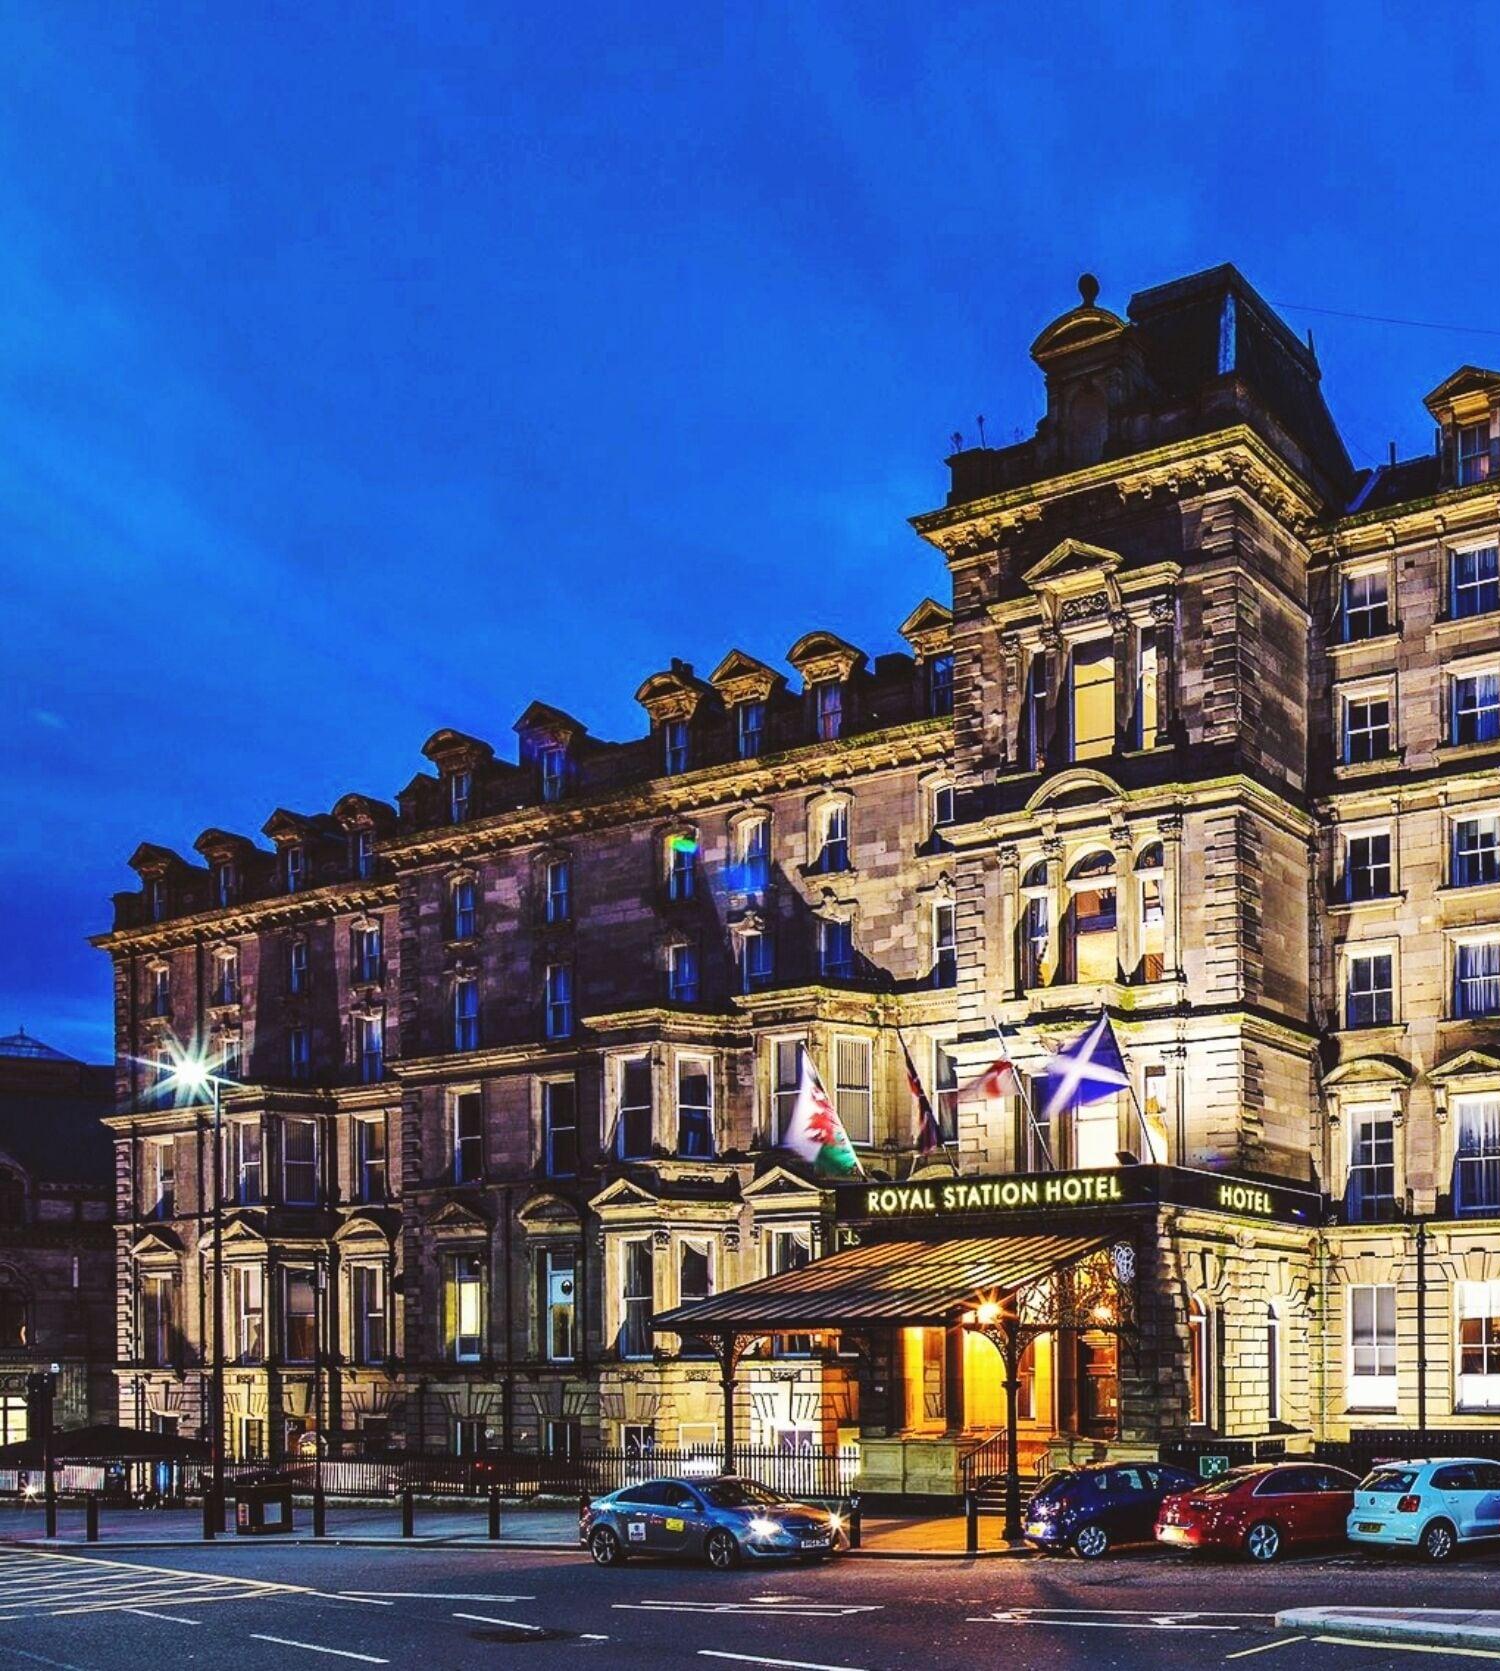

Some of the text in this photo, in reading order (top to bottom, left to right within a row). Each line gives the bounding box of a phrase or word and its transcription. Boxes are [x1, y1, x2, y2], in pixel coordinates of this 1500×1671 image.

[867, 1176, 1122, 1213] ROYAL STATION HOTEL
[1220, 1184, 1273, 1214] HOTEL
